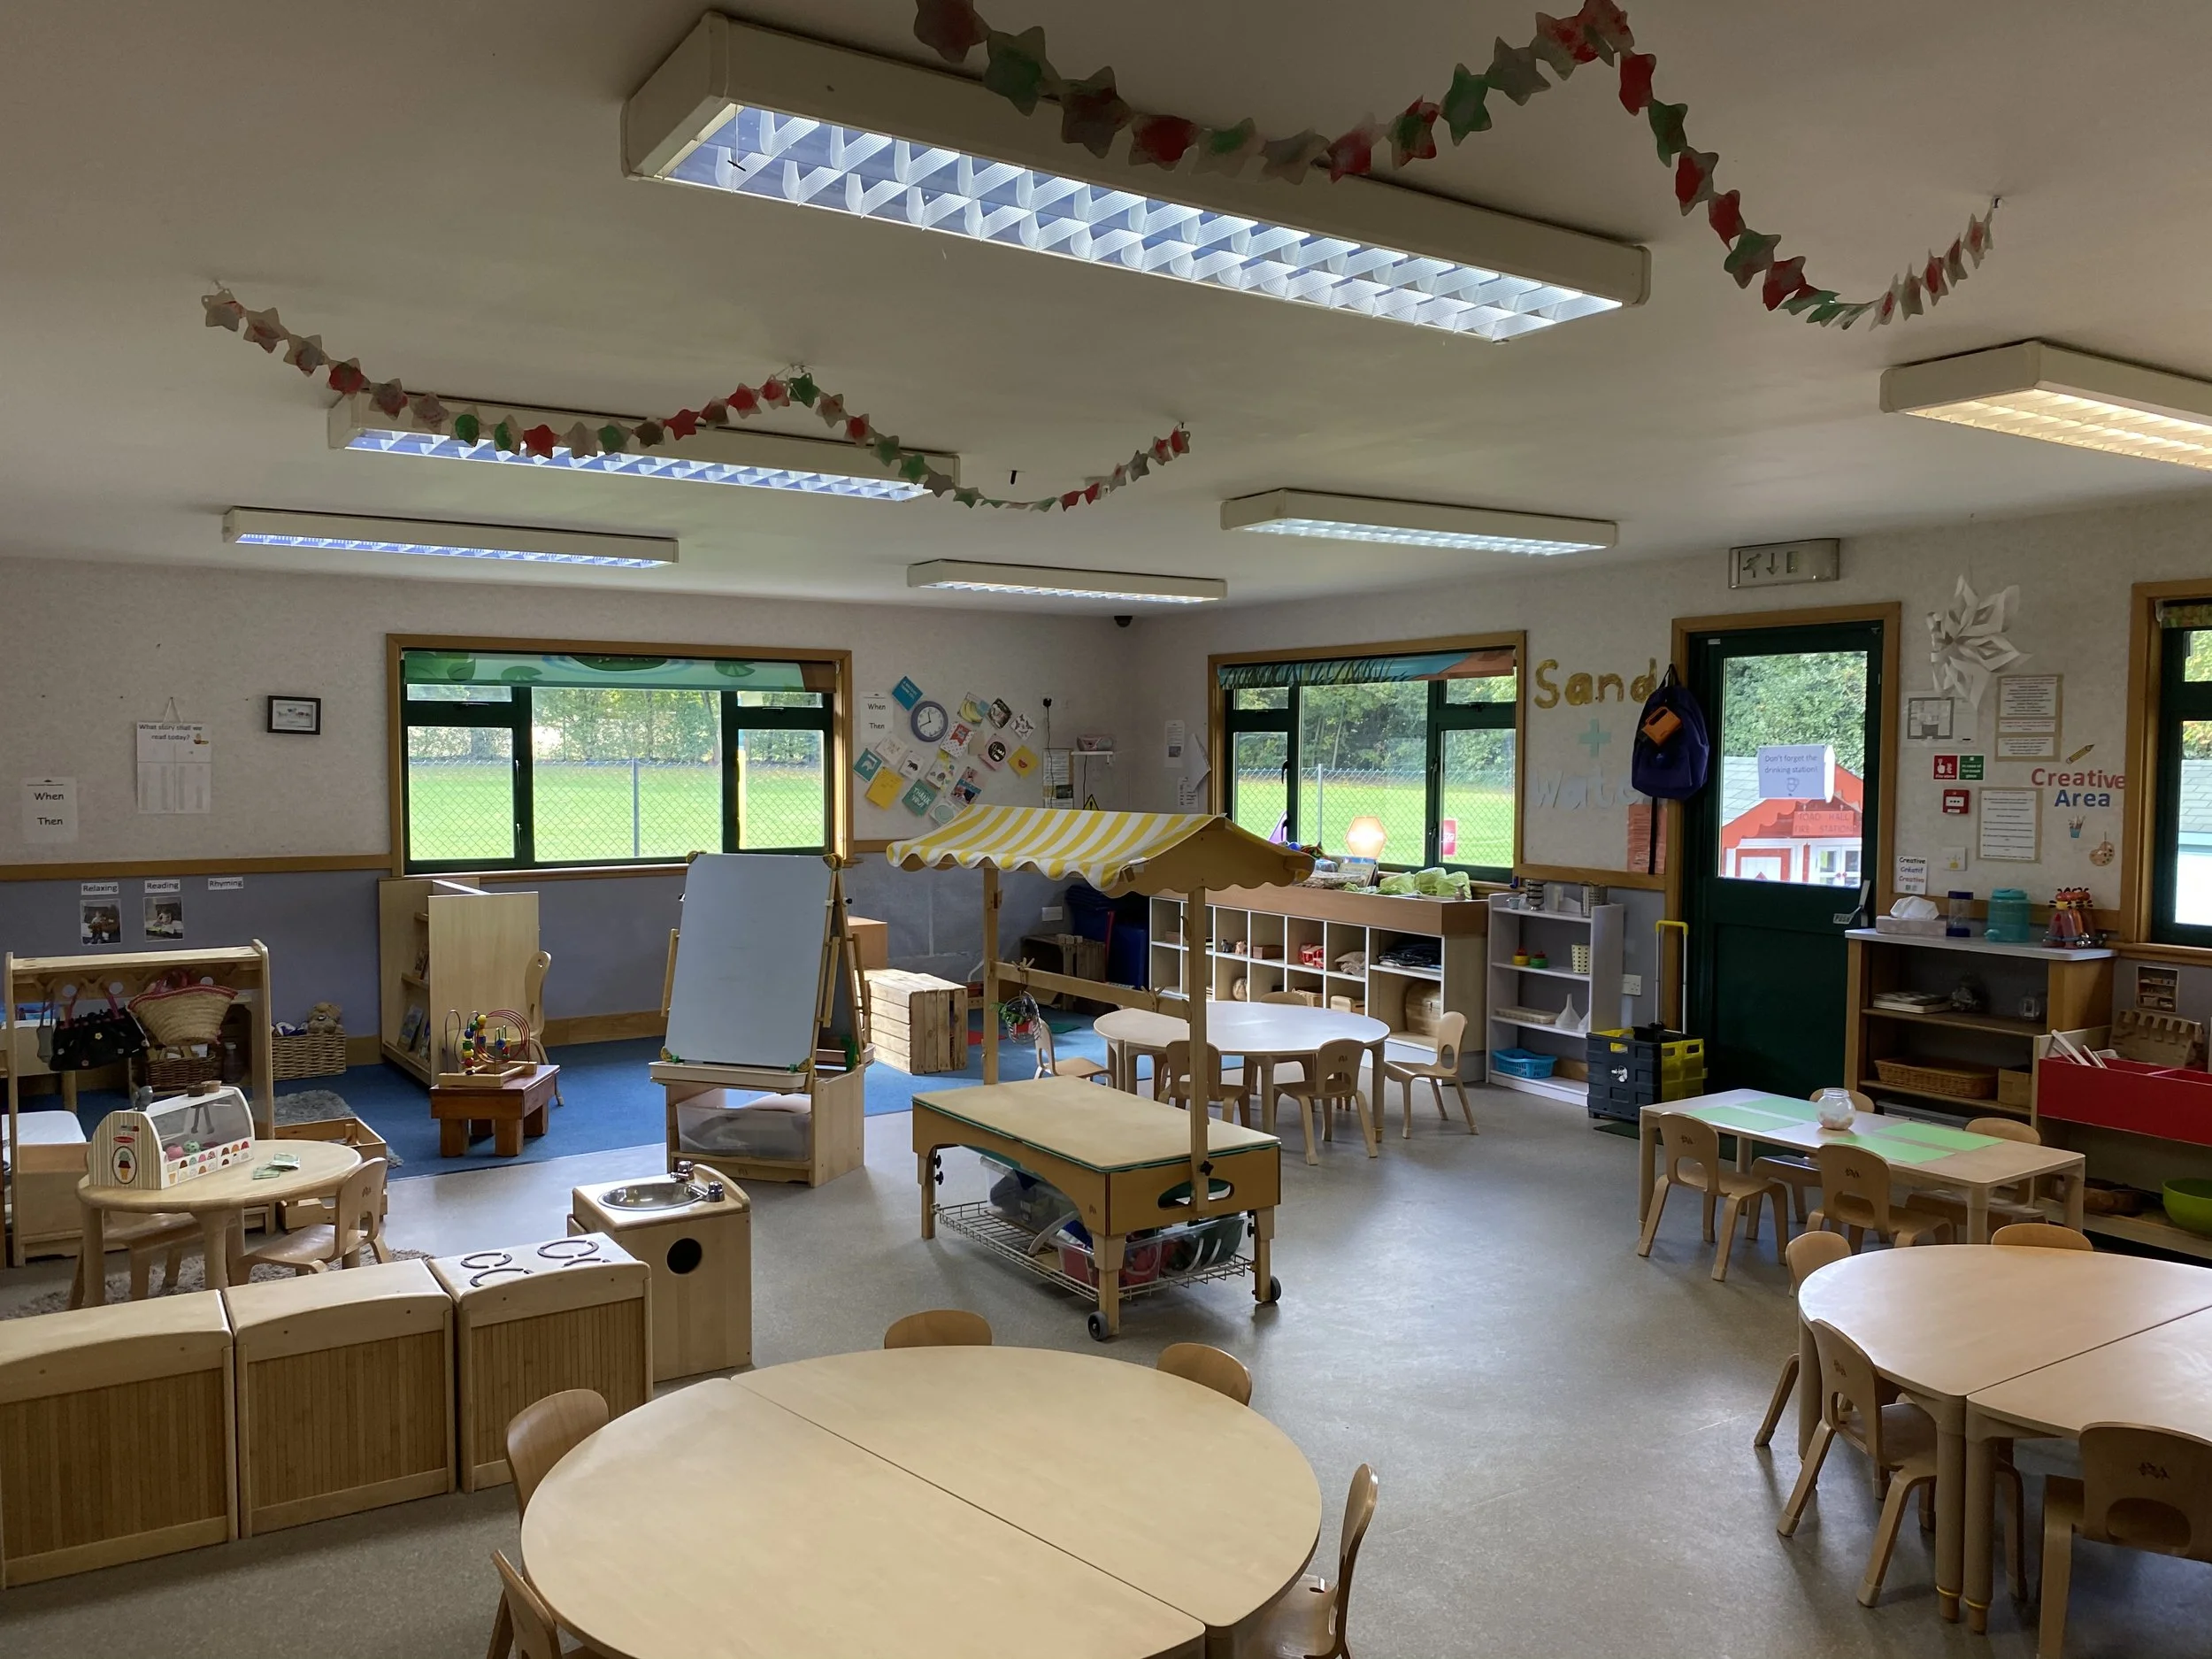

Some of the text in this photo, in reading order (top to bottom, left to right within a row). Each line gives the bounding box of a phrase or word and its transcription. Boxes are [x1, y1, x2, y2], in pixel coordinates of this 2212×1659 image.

[1533, 657, 1657, 710] Sand
[1784, 755, 1804, 764] forget
[2031, 768, 2126, 790] Creative
[34, 792, 65, 801] When
[913, 787, 932, 807] THANK
[2054, 789, 2111, 808] Area
[36, 817, 64, 826] Then
[1819, 824, 1854, 833] STATION
[146, 882, 179, 891] Reading
[209, 879, 243, 888] Rhyming
